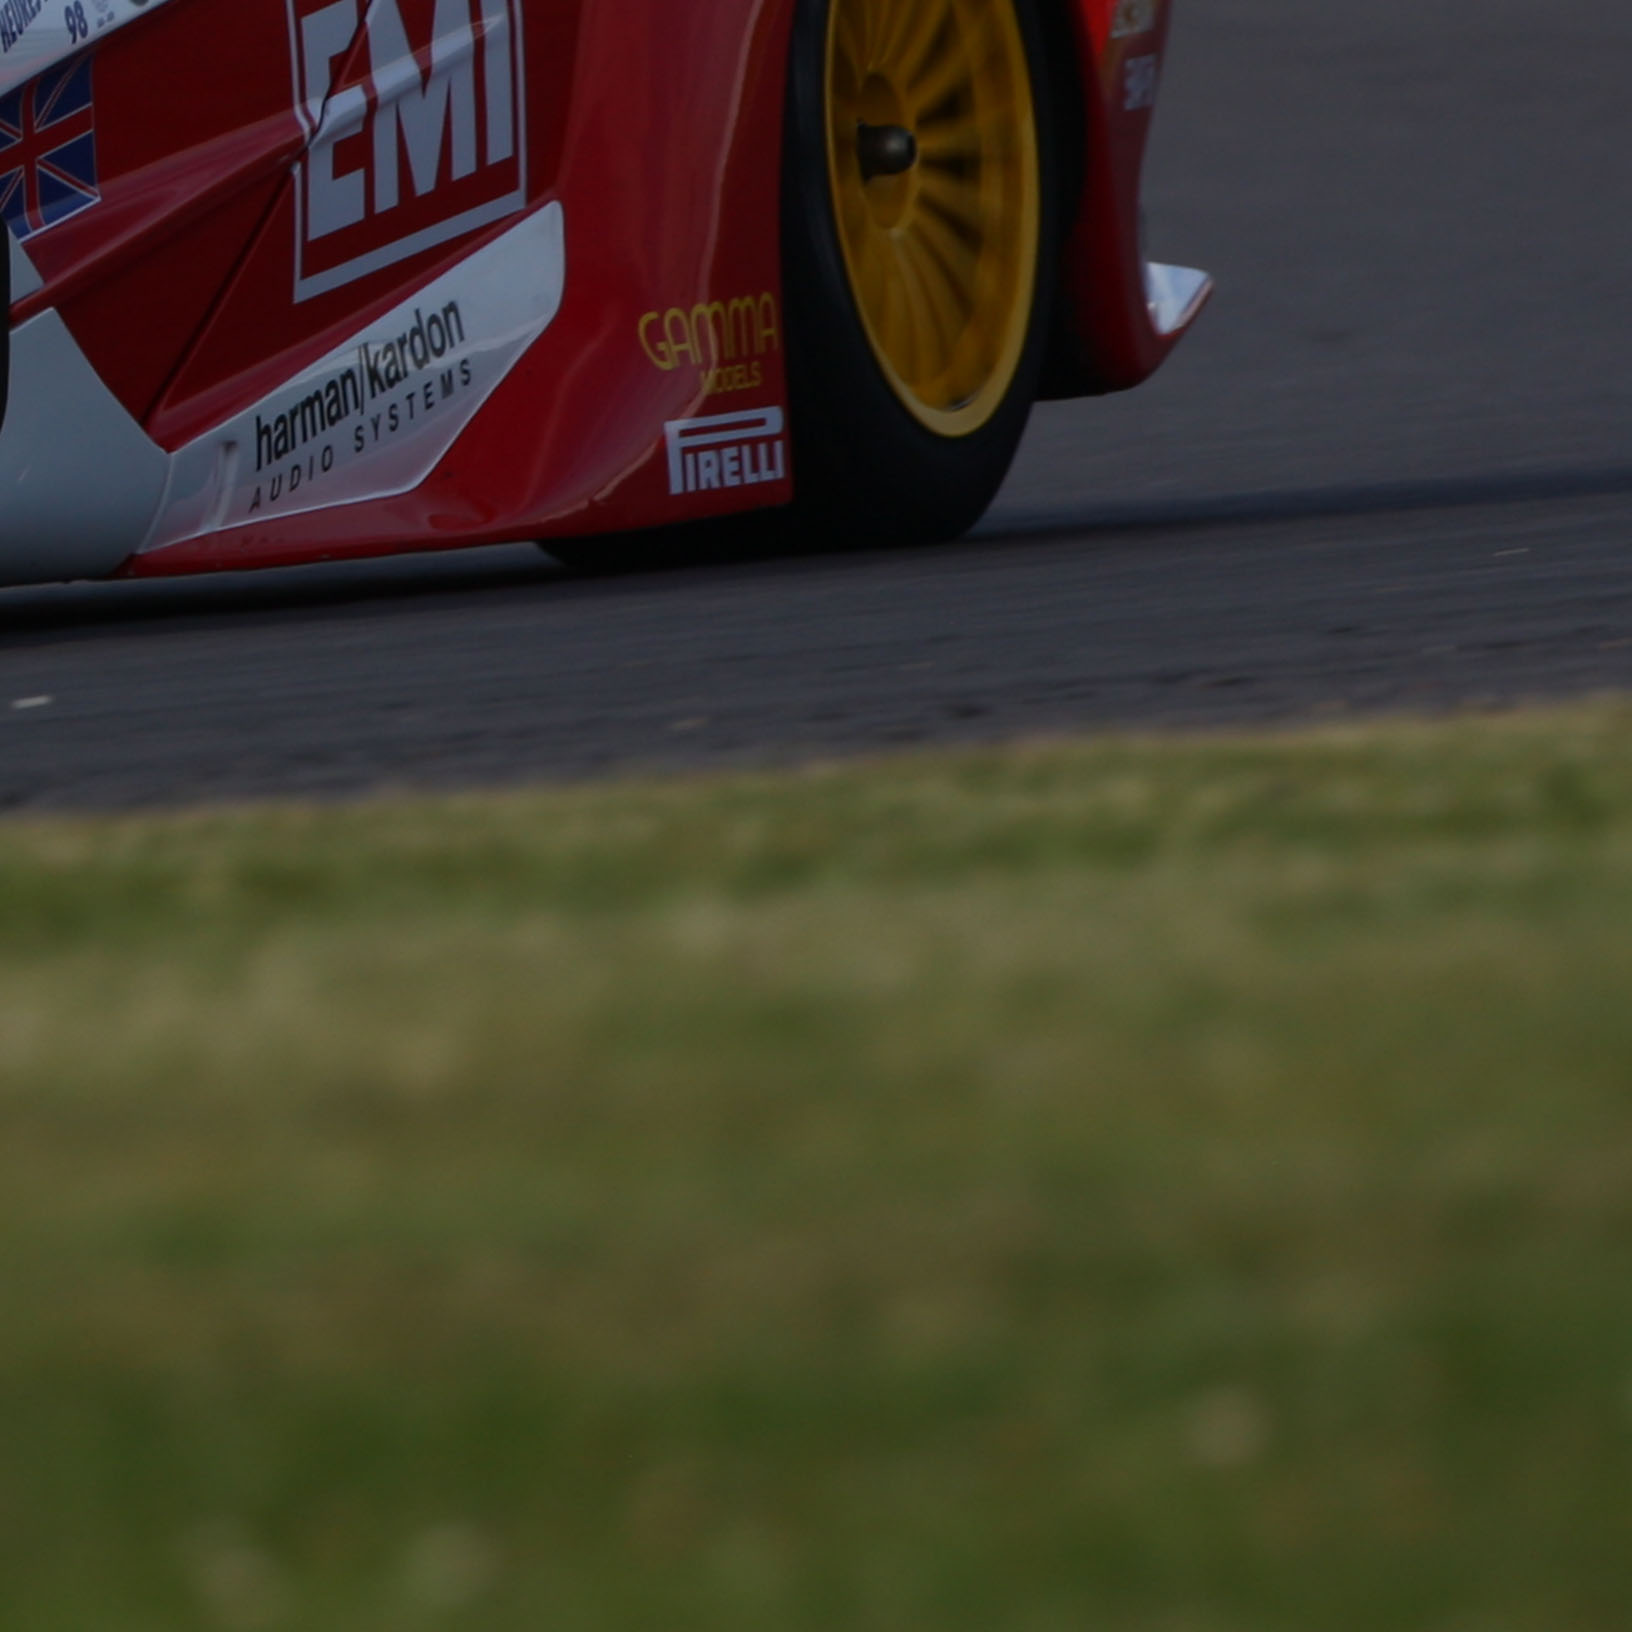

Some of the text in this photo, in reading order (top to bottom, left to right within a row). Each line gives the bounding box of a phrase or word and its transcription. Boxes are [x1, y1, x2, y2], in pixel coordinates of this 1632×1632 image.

[64, 0, 89, 45] 98
[638, 291, 777, 371] GAMMA
[253, 301, 465, 472] harman/kardon
[248, 364, 474, 512] AUDIO SYSTEMS
[664, 406, 785, 497] PIRELLI
